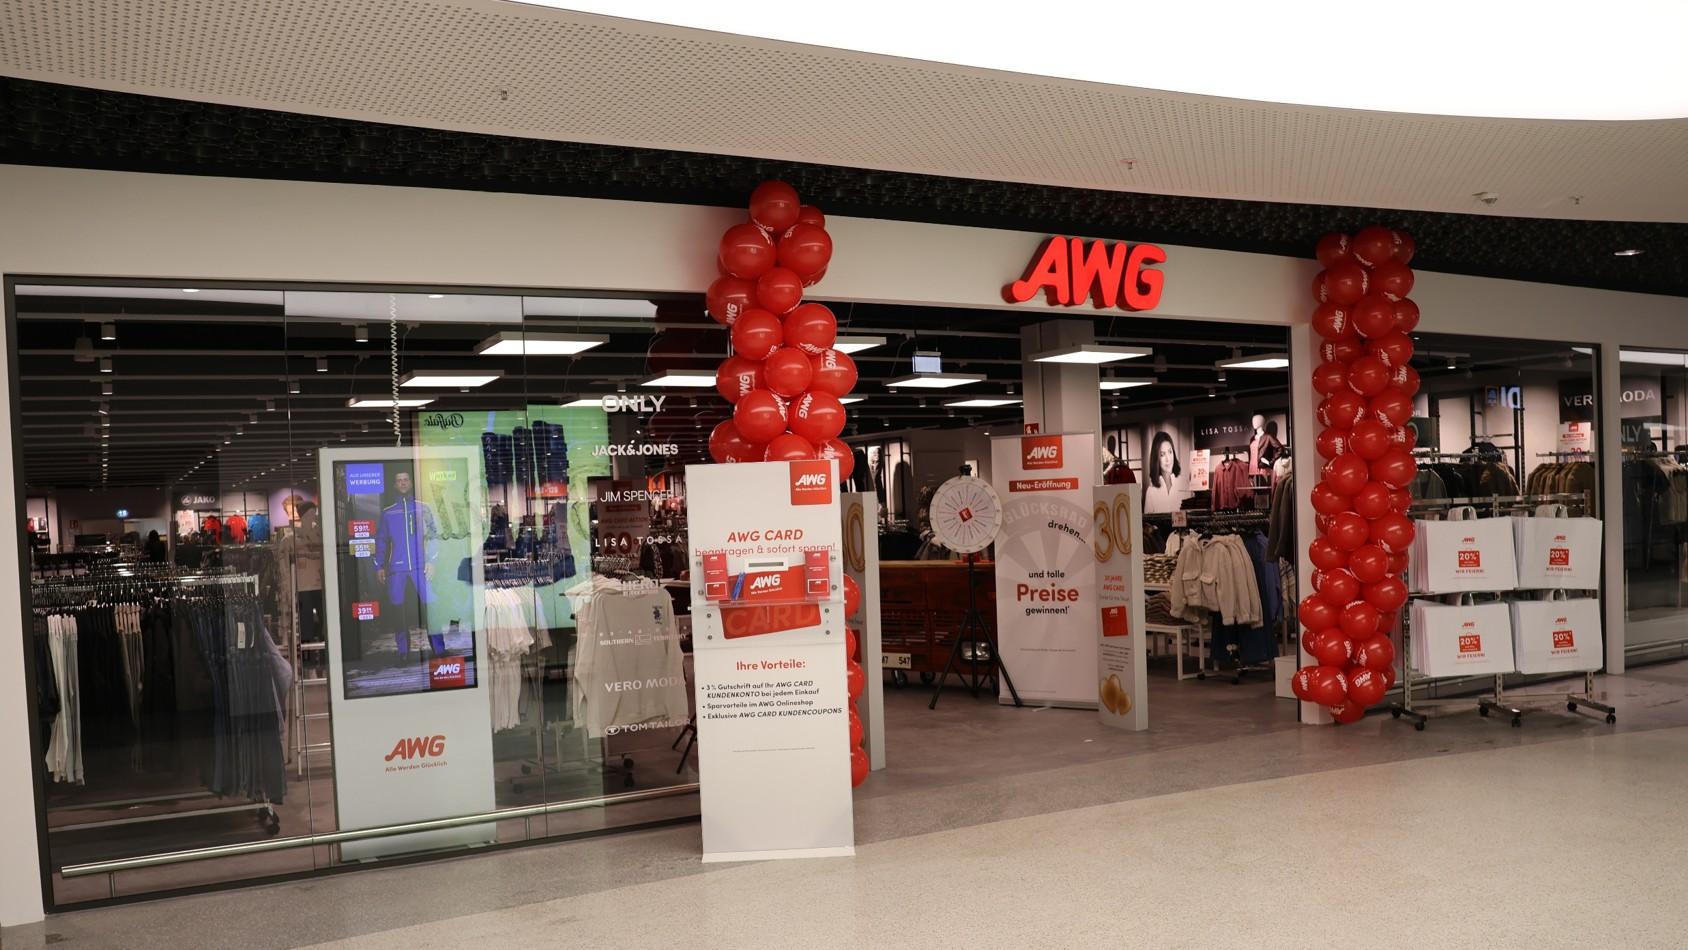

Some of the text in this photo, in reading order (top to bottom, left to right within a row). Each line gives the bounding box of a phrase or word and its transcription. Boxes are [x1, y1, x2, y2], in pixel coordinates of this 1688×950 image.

[1004, 236, 1167, 311] AWG
[1333, 310, 1344, 333] AWG
[1564, 390, 1656, 407] VER ODA
[799, 394, 813, 420] AWG
[1201, 427, 1219, 436] LISA
[592, 444, 679, 457] JACK&JONES
[1027, 446, 1058, 460] AWG
[350, 478, 381, 486] WERBUNG
[795, 473, 827, 486] AWG
[1016, 480, 1071, 490] Neu-Eröffnung
[192, 495, 216, 504] JAKO
[600, 490, 673, 503] JIM SPENCER
[1094, 493, 1132, 563] 30
[595, 537, 628, 548] LISA
[727, 529, 804, 543] AWG CARD
[757, 544, 764, 554] &
[766, 543, 796, 554] sofort
[1028, 570, 1065, 579] und tolle
[750, 574, 781, 590] AWG
[1016, 582, 1080, 602] Preise
[724, 604, 816, 636] CARD
[433, 663, 461, 676] AWG
[736, 659, 806, 671] Ihre Vorteile:
[605, 680, 642, 693] VERO
[717, 682, 751, 691] Gutschrift
[707, 691, 760, 699] KUNDENKONTO
[773, 690, 794, 698] jedem
[795, 688, 820, 696] Einkauf
[707, 701, 748, 710] Sparvorteile
[776, 699, 814, 707] Onlineshop
[739, 711, 756, 719] AWG
[757, 710, 777, 718] CARD
[778, 708, 843, 717] KUNDENCOUPONS
[622, 723, 648, 733] TOM
[649, 719, 691, 730] TAILOR
[384, 735, 446, 762] AWG
[421, 761, 448, 769] Glücklich
